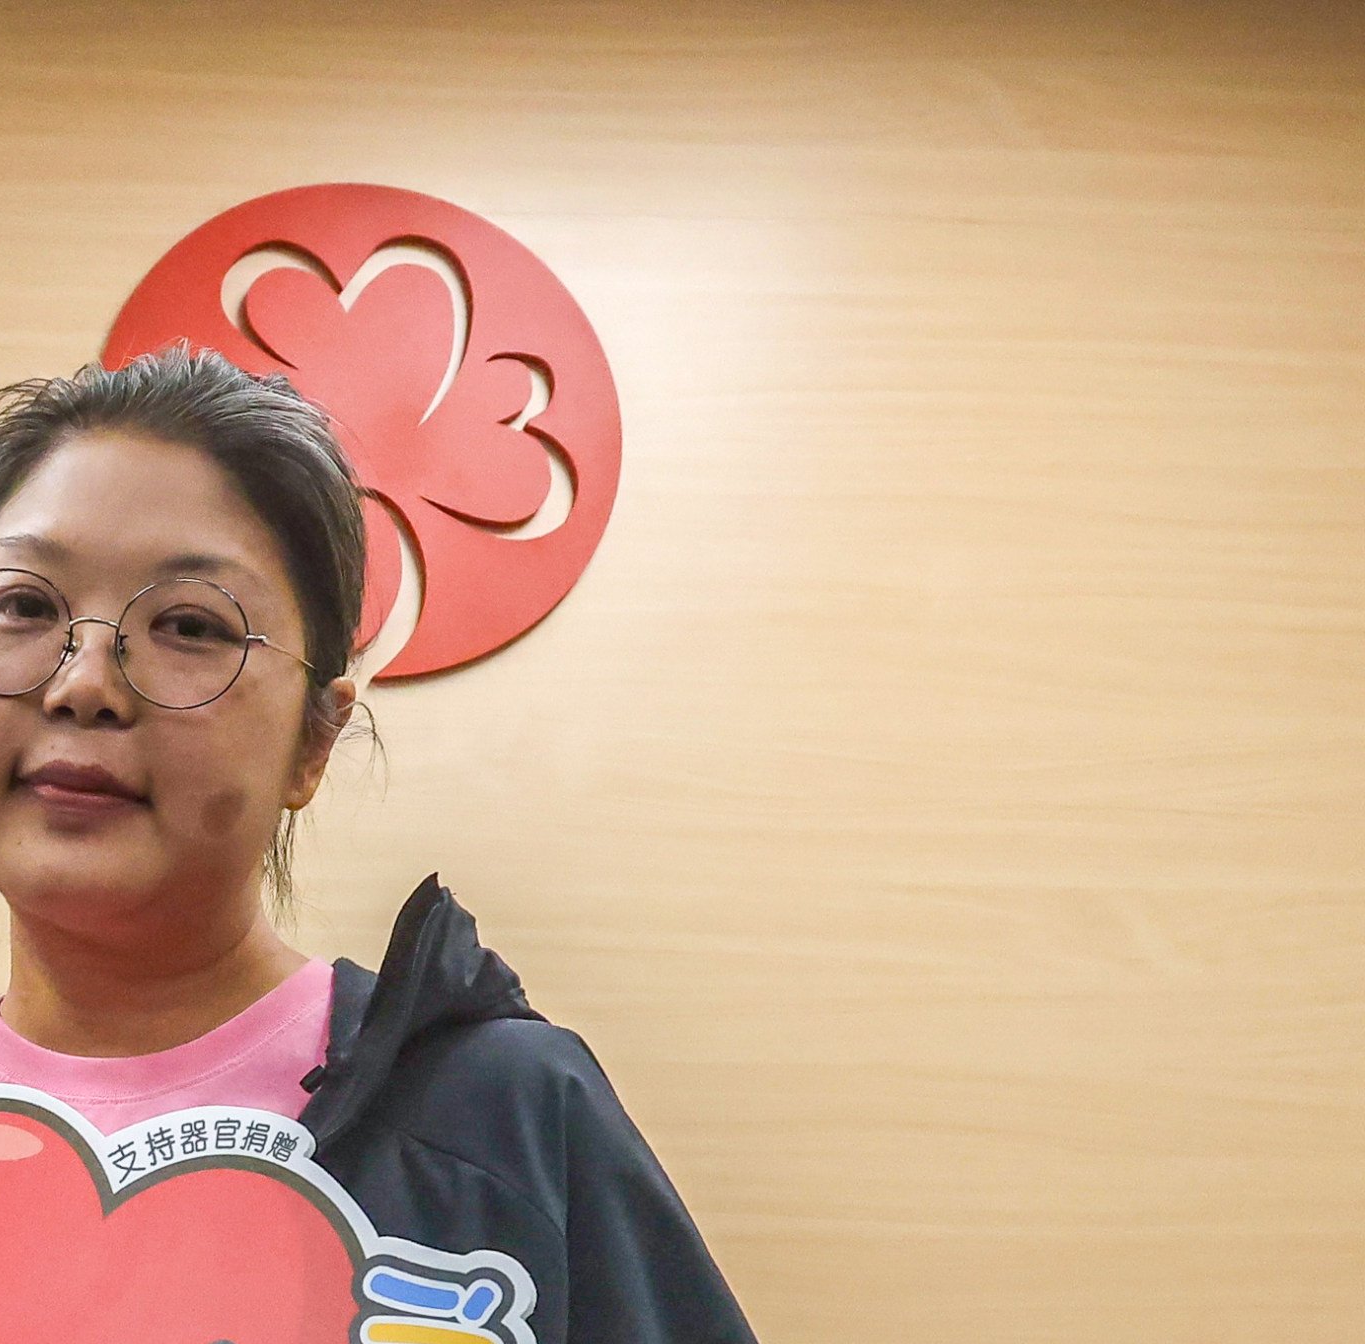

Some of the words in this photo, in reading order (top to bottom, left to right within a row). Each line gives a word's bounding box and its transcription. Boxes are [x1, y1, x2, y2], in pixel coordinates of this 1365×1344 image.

[107, 1117, 300, 1183] 支持器官捐贈
